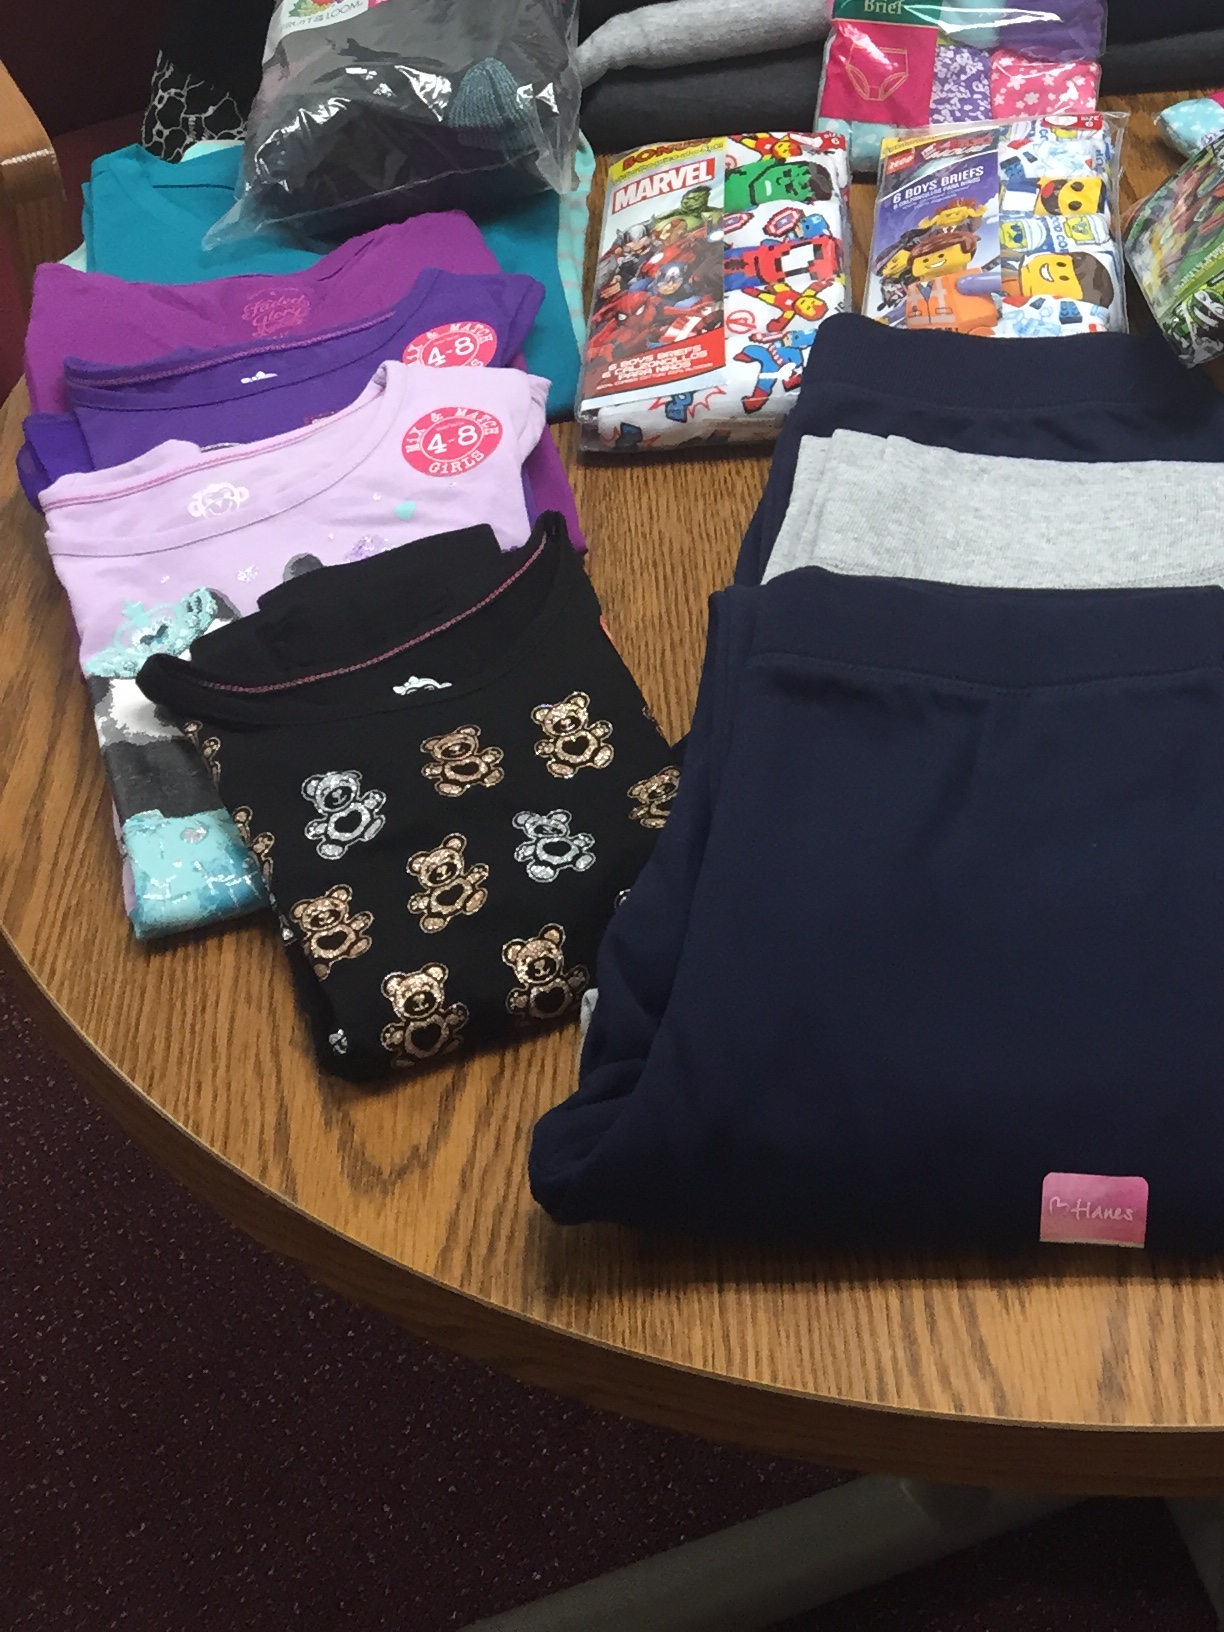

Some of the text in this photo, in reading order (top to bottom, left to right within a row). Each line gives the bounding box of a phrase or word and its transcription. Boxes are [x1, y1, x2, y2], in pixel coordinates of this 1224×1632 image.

[613, 160, 713, 213] MARVEL
[893, 193, 901, 204] 6
[905, 179, 938, 199] BOYS
[941, 165, 984, 186] BRIEFS
[450, 323, 494, 345] MATCH
[428, 336, 474, 366] 4-8
[620, 353, 654, 368] BOYS
[656, 344, 702, 360] BRIEFS
[455, 406, 500, 435] MATCH
[427, 425, 478, 454] 4-8
[1070, 1198, 1134, 1221] Hanes
